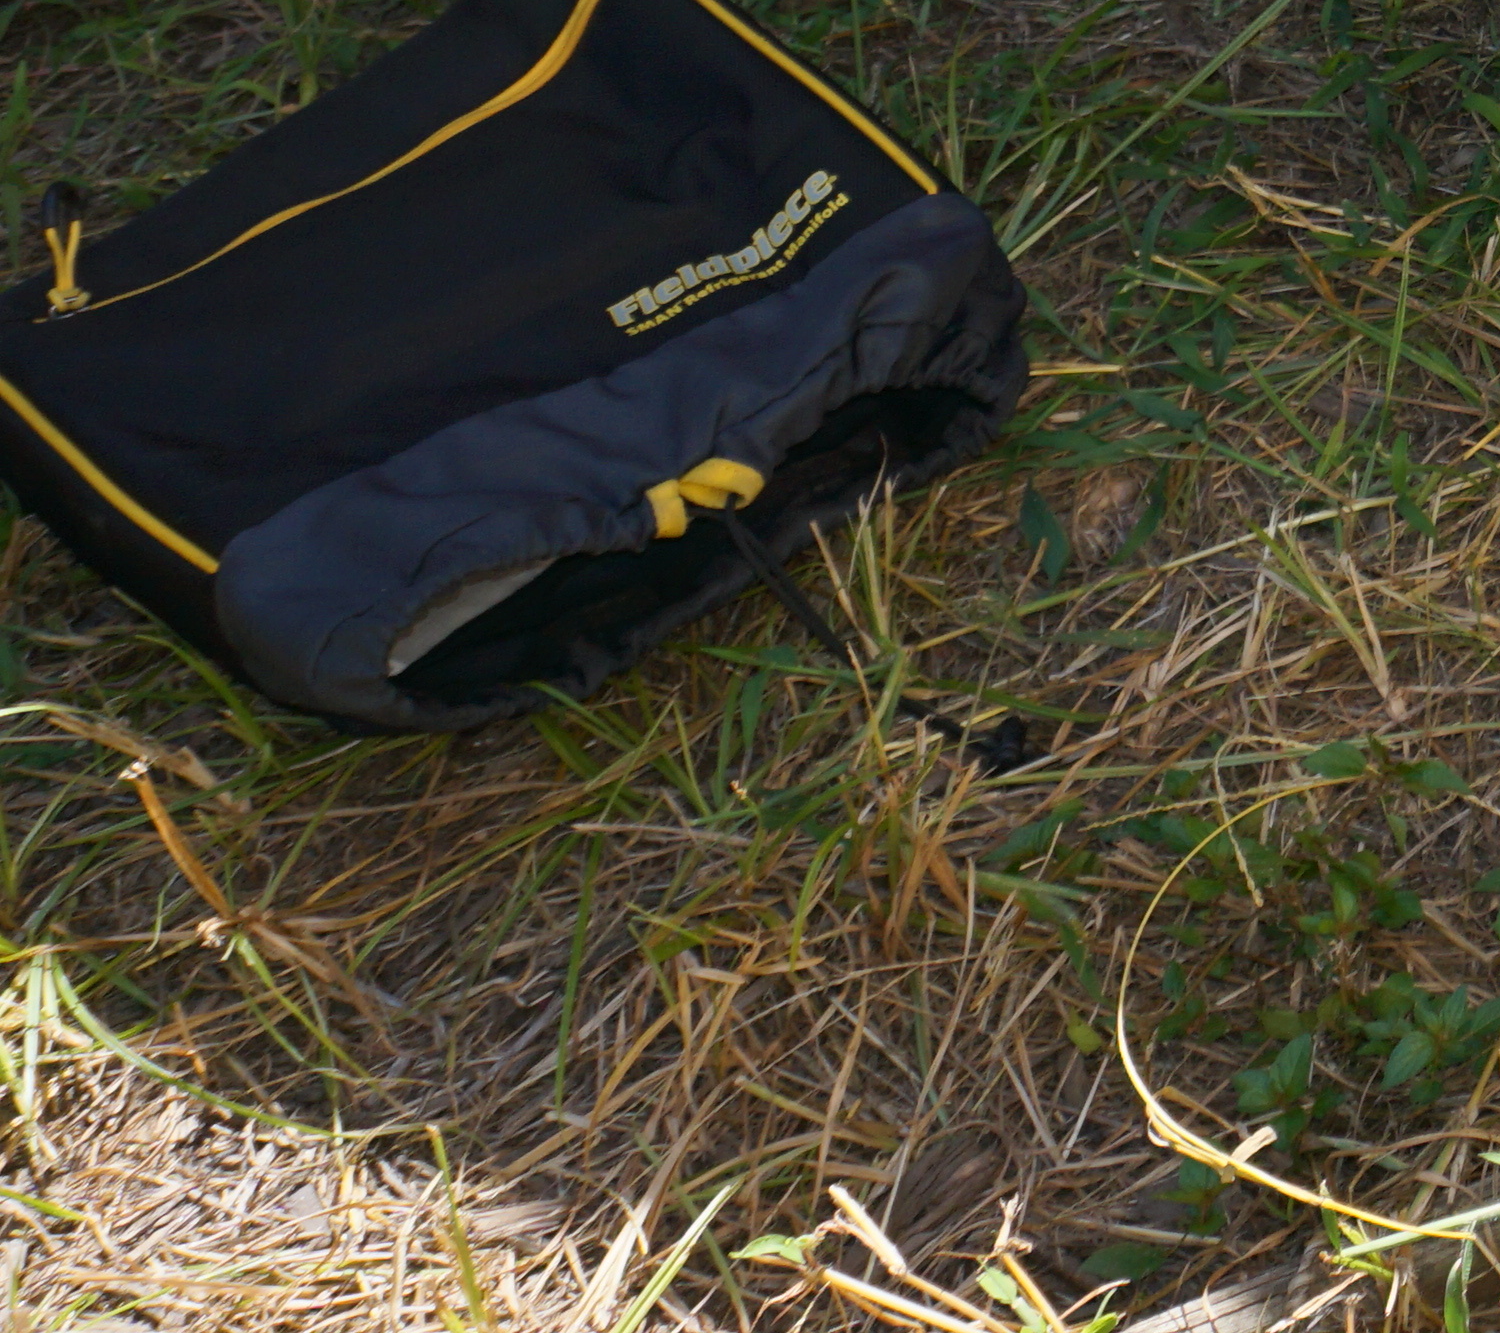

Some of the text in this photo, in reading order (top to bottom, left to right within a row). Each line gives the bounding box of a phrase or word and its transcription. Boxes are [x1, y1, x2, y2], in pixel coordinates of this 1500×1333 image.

[606, 170, 834, 328] Fieldpiece
[625, 192, 849, 336] SMAN Refrigerant Manifold
